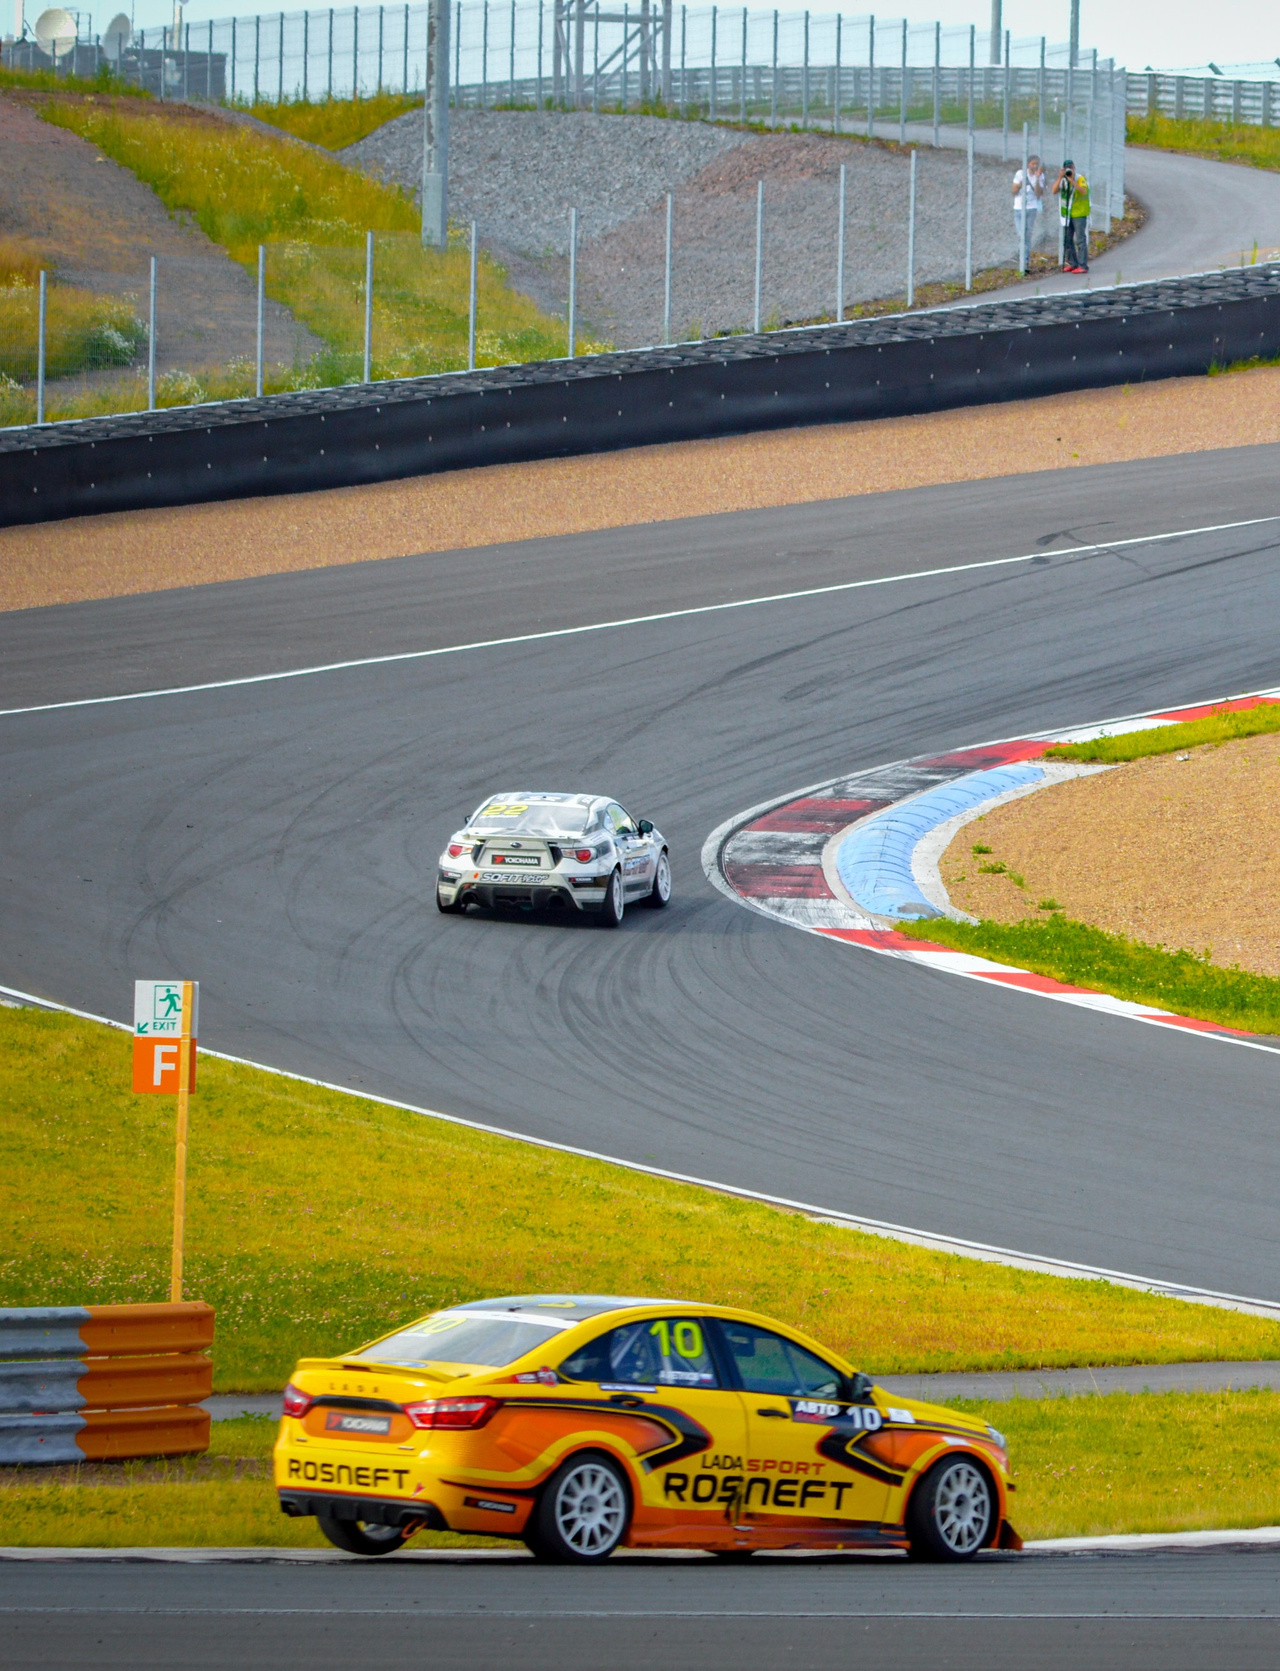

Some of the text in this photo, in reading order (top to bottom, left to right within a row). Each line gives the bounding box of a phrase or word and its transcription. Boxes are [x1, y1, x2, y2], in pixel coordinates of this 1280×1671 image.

[482, 804, 528, 815] 22
[504, 856, 539, 865] YOKOHAMA
[481, 872, 523, 883] SOFIT
[152, 1021, 177, 1031] EXIT
[152, 1044, 178, 1086] F
[649, 1320, 704, 1359] 10
[795, 1400, 882, 1431] АВТО 10
[288, 1458, 411, 1490] ROSNEFT
[701, 1453, 827, 1476] LADA SPORT
[663, 1471, 854, 1511] ROSNEFT
